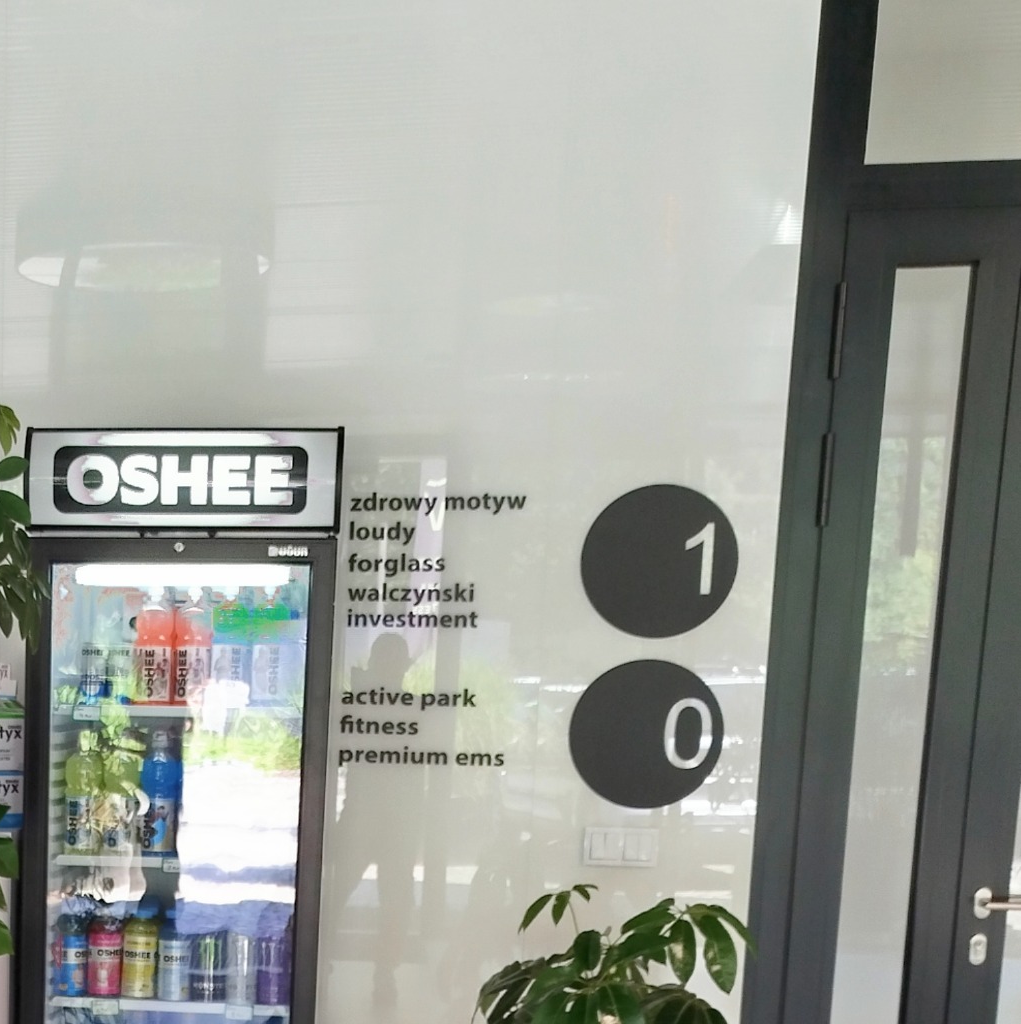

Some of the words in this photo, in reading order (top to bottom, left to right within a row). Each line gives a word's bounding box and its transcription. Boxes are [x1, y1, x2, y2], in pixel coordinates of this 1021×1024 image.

[67, 454, 293, 506] OSHEE
[350, 493, 444, 515] zdrowy
[445, 493, 527, 514] motyw
[349, 521, 416, 546] loudy
[348, 554, 446, 577] forglass
[684, 522, 716, 595] 1
[348, 583, 475, 607] walczyński
[347, 610, 478, 628] investment
[177, 650, 188, 698] OSHEE
[232, 648, 242, 684] SHEE
[341, 689, 413, 707] active
[420, 688, 476, 711] park
[340, 716, 419, 735] fitness
[664, 698, 713, 770] 0
[338, 746, 448, 768] premium
[455, 751, 505, 767] ems
